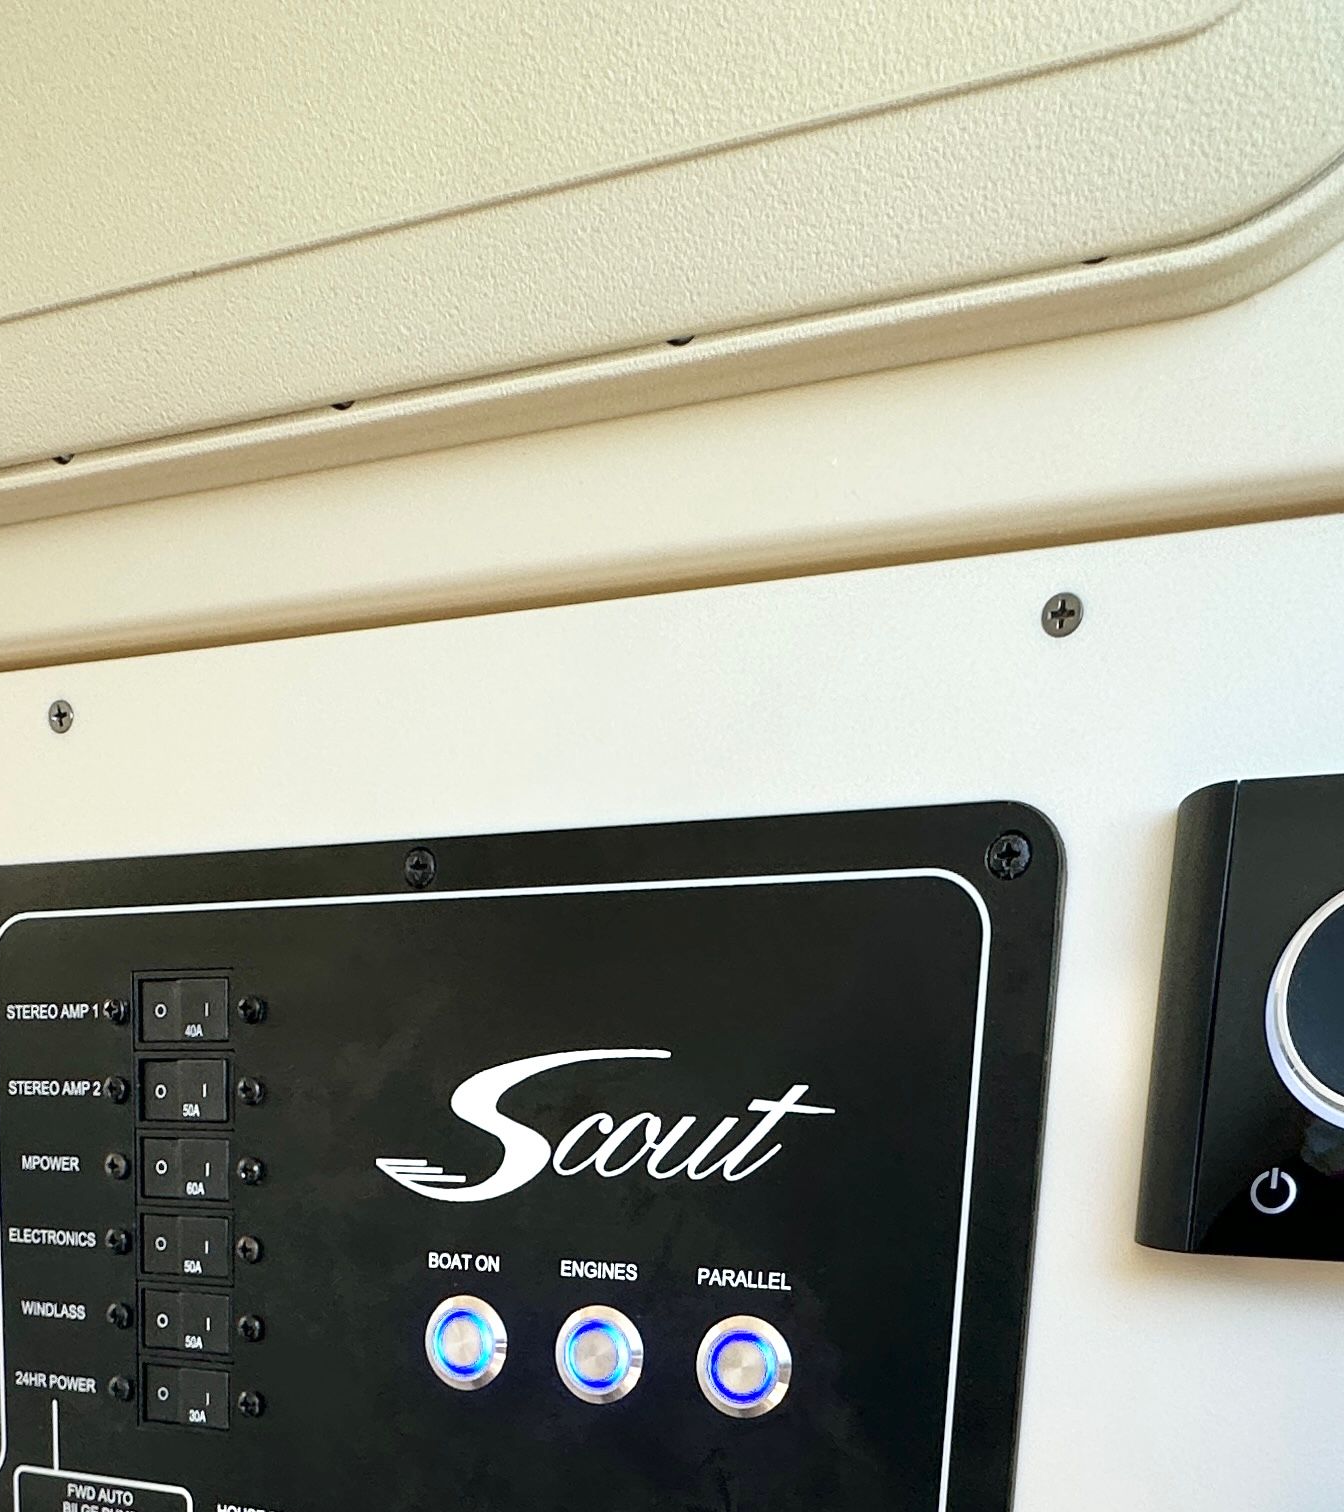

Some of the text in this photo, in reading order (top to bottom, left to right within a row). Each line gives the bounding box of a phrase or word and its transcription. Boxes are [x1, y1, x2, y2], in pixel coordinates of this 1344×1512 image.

[7, 1003, 99, 1020] STEREO AMP 1
[9, 1080, 101, 1096] STEREO AMP 2
[375, 1048, 836, 1202] Scout
[22, 1156, 79, 1172] MPOWER
[9, 1228, 96, 1248] ELECTRONICS
[428, 1252, 500, 1273] BOAT ON
[560, 1261, 638, 1282] ENGINES
[698, 1268, 792, 1291] PARALLEL
[21, 1301, 85, 1320] WINDLASS
[15, 1372, 96, 1393] 24HR POWER
[68, 1484, 134, 1507] FWD AUTO
